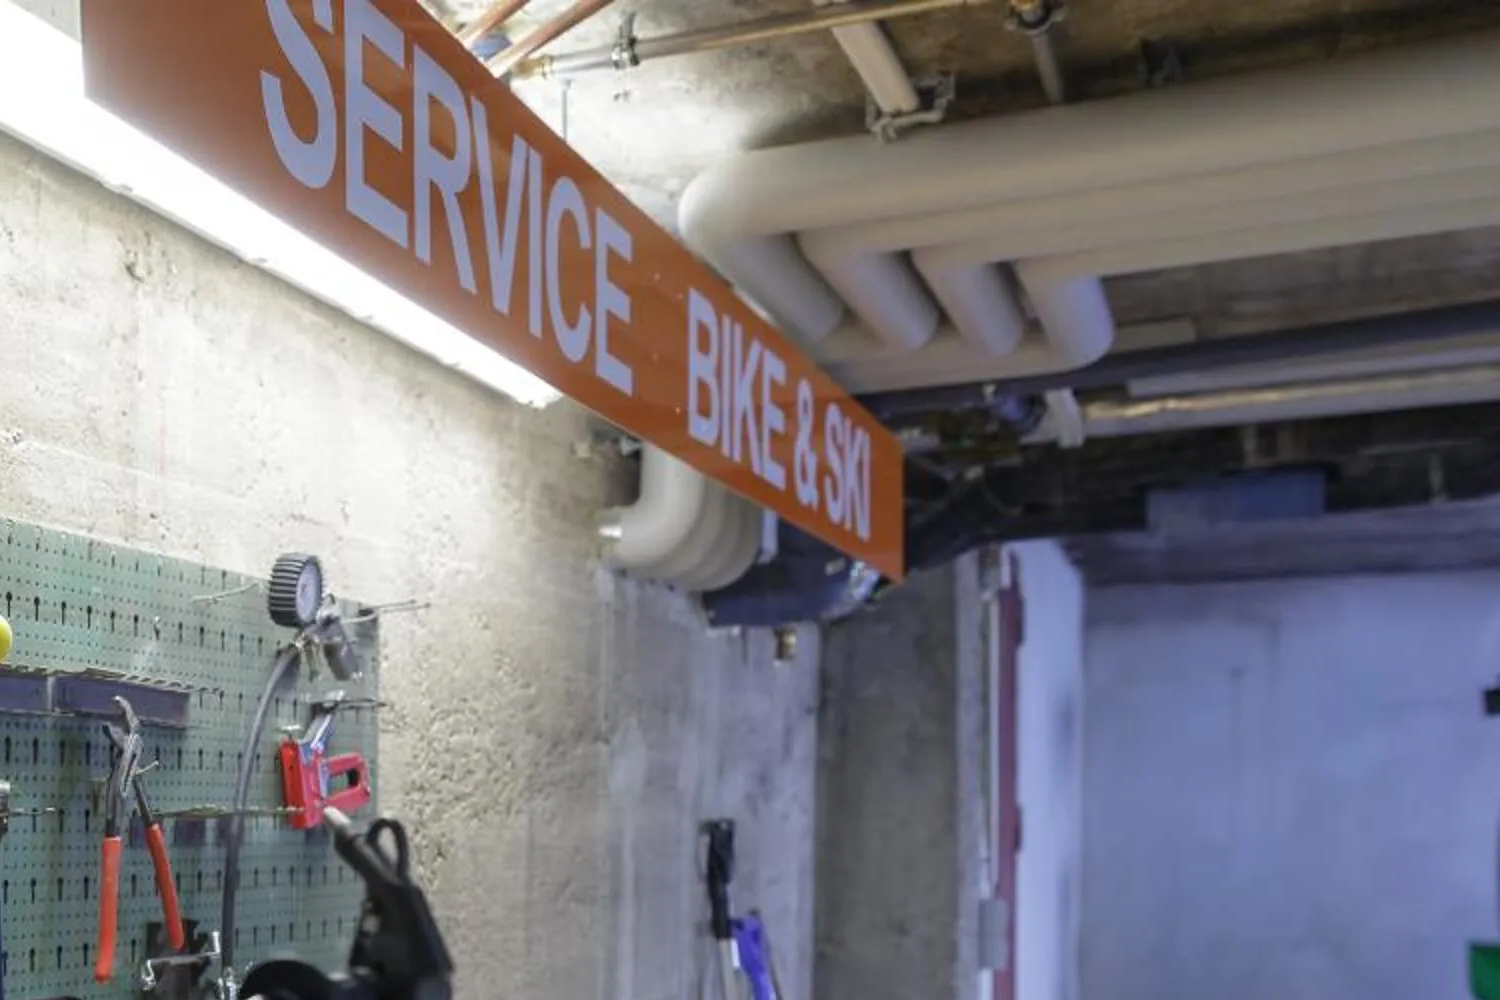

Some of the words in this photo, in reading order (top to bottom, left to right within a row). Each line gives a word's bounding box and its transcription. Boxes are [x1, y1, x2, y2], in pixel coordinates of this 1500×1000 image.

[261, 0, 634, 395] SERVICE
[687, 289, 787, 492] BIKE
[793, 379, 818, 508] &
[824, 405, 871, 543] SKI
